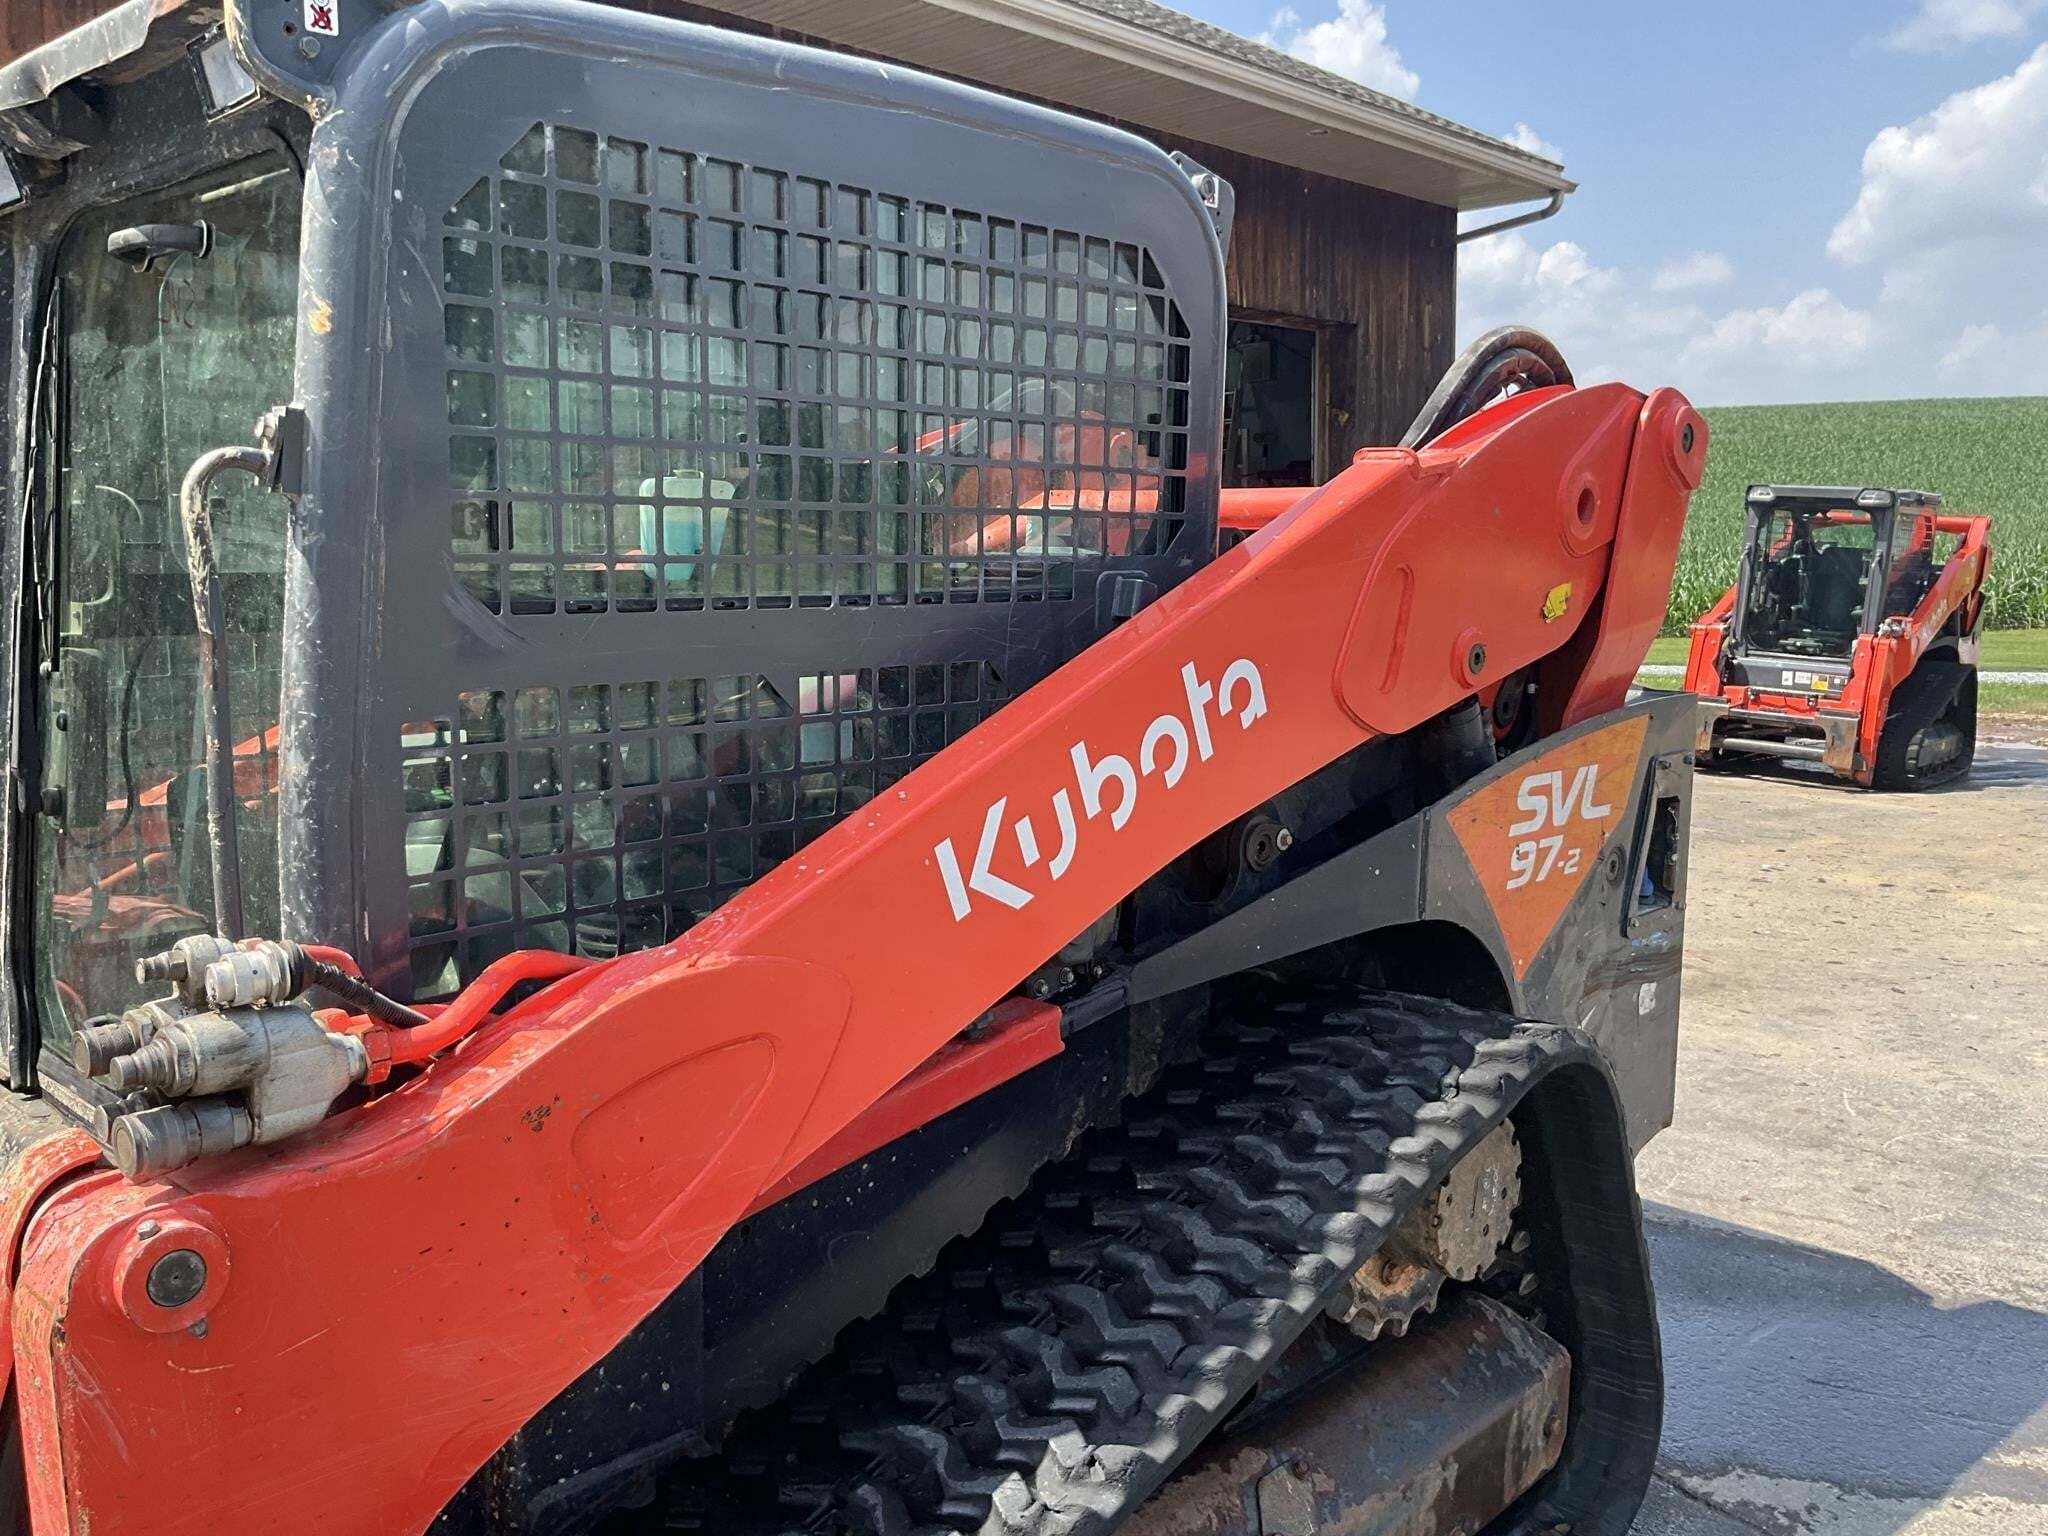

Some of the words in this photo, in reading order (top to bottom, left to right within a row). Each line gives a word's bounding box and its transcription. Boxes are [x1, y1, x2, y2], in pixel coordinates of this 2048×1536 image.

[934, 658, 1268, 922] Kubota
[1508, 764, 1612, 837] SVL
[1506, 835, 1581, 890] 97-2
